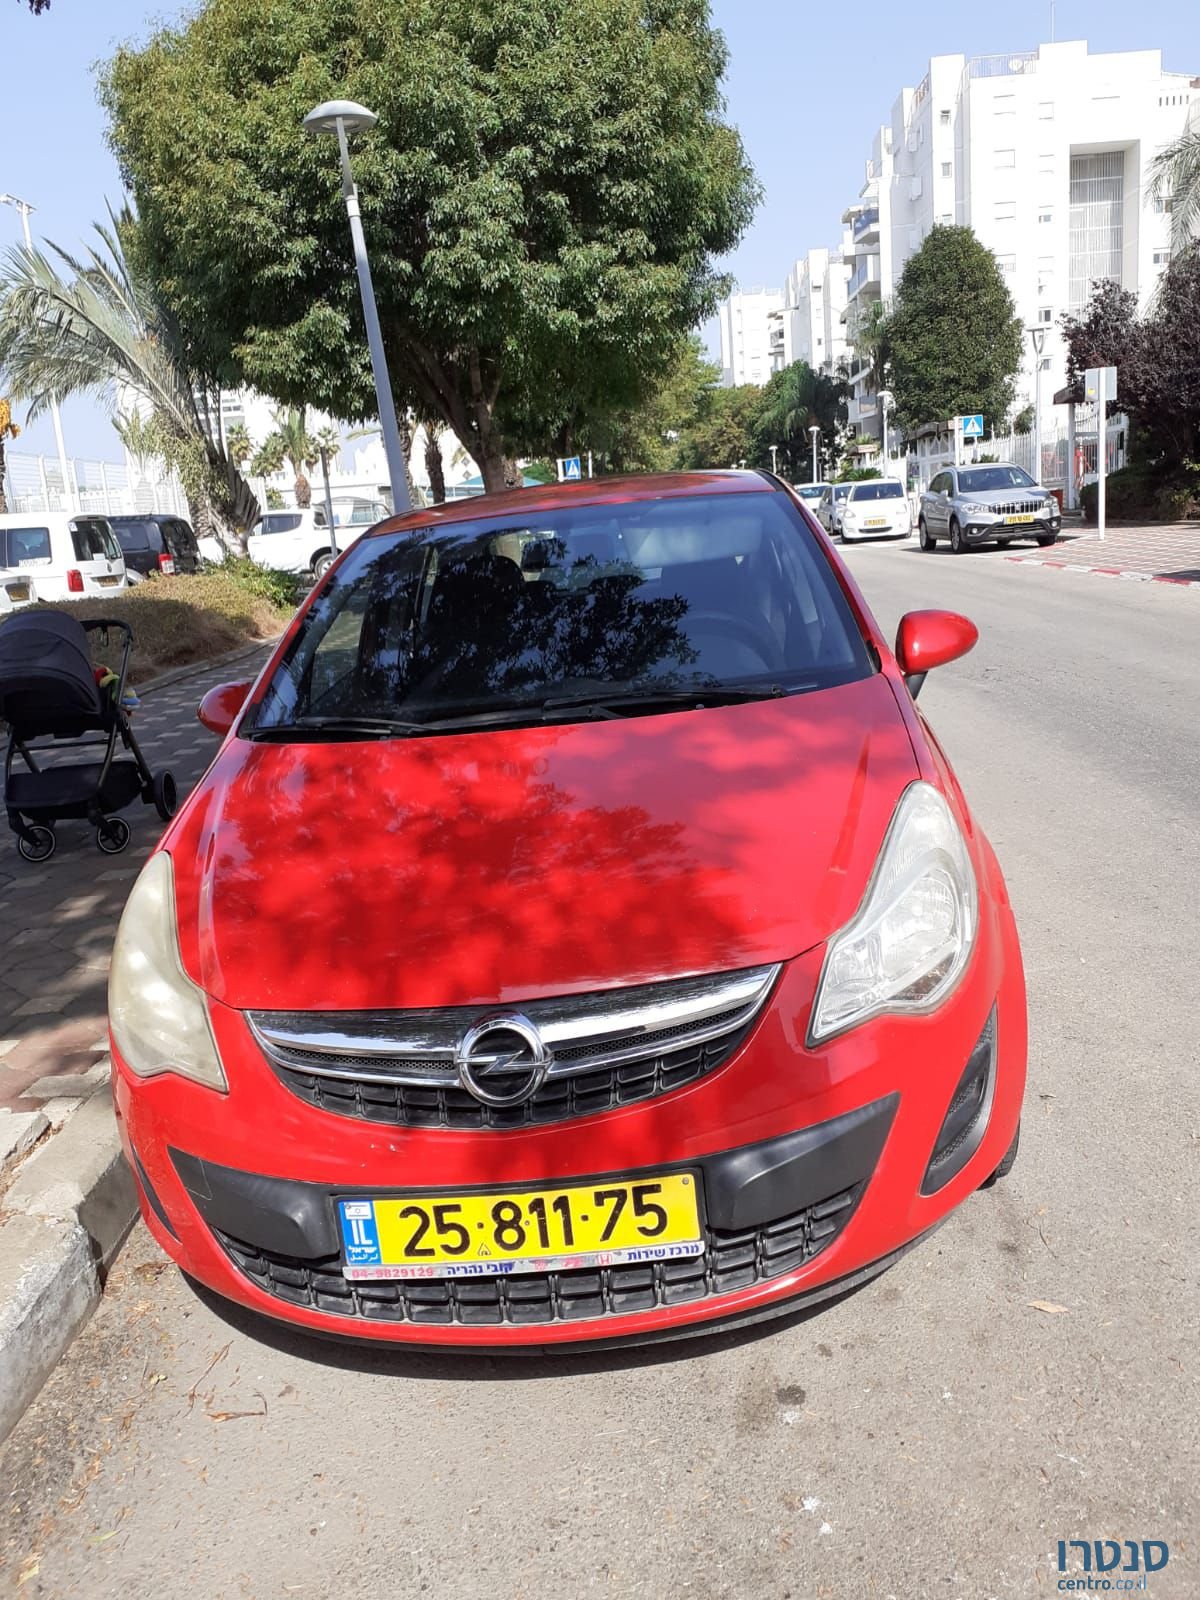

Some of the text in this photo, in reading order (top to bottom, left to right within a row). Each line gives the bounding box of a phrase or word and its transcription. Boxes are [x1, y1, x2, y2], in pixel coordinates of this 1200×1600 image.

[351, 1219, 373, 1245] IL
[627, 1244, 699, 1261] מרכז שירות
[447, 1261, 515, 1276] קובי נהריה
